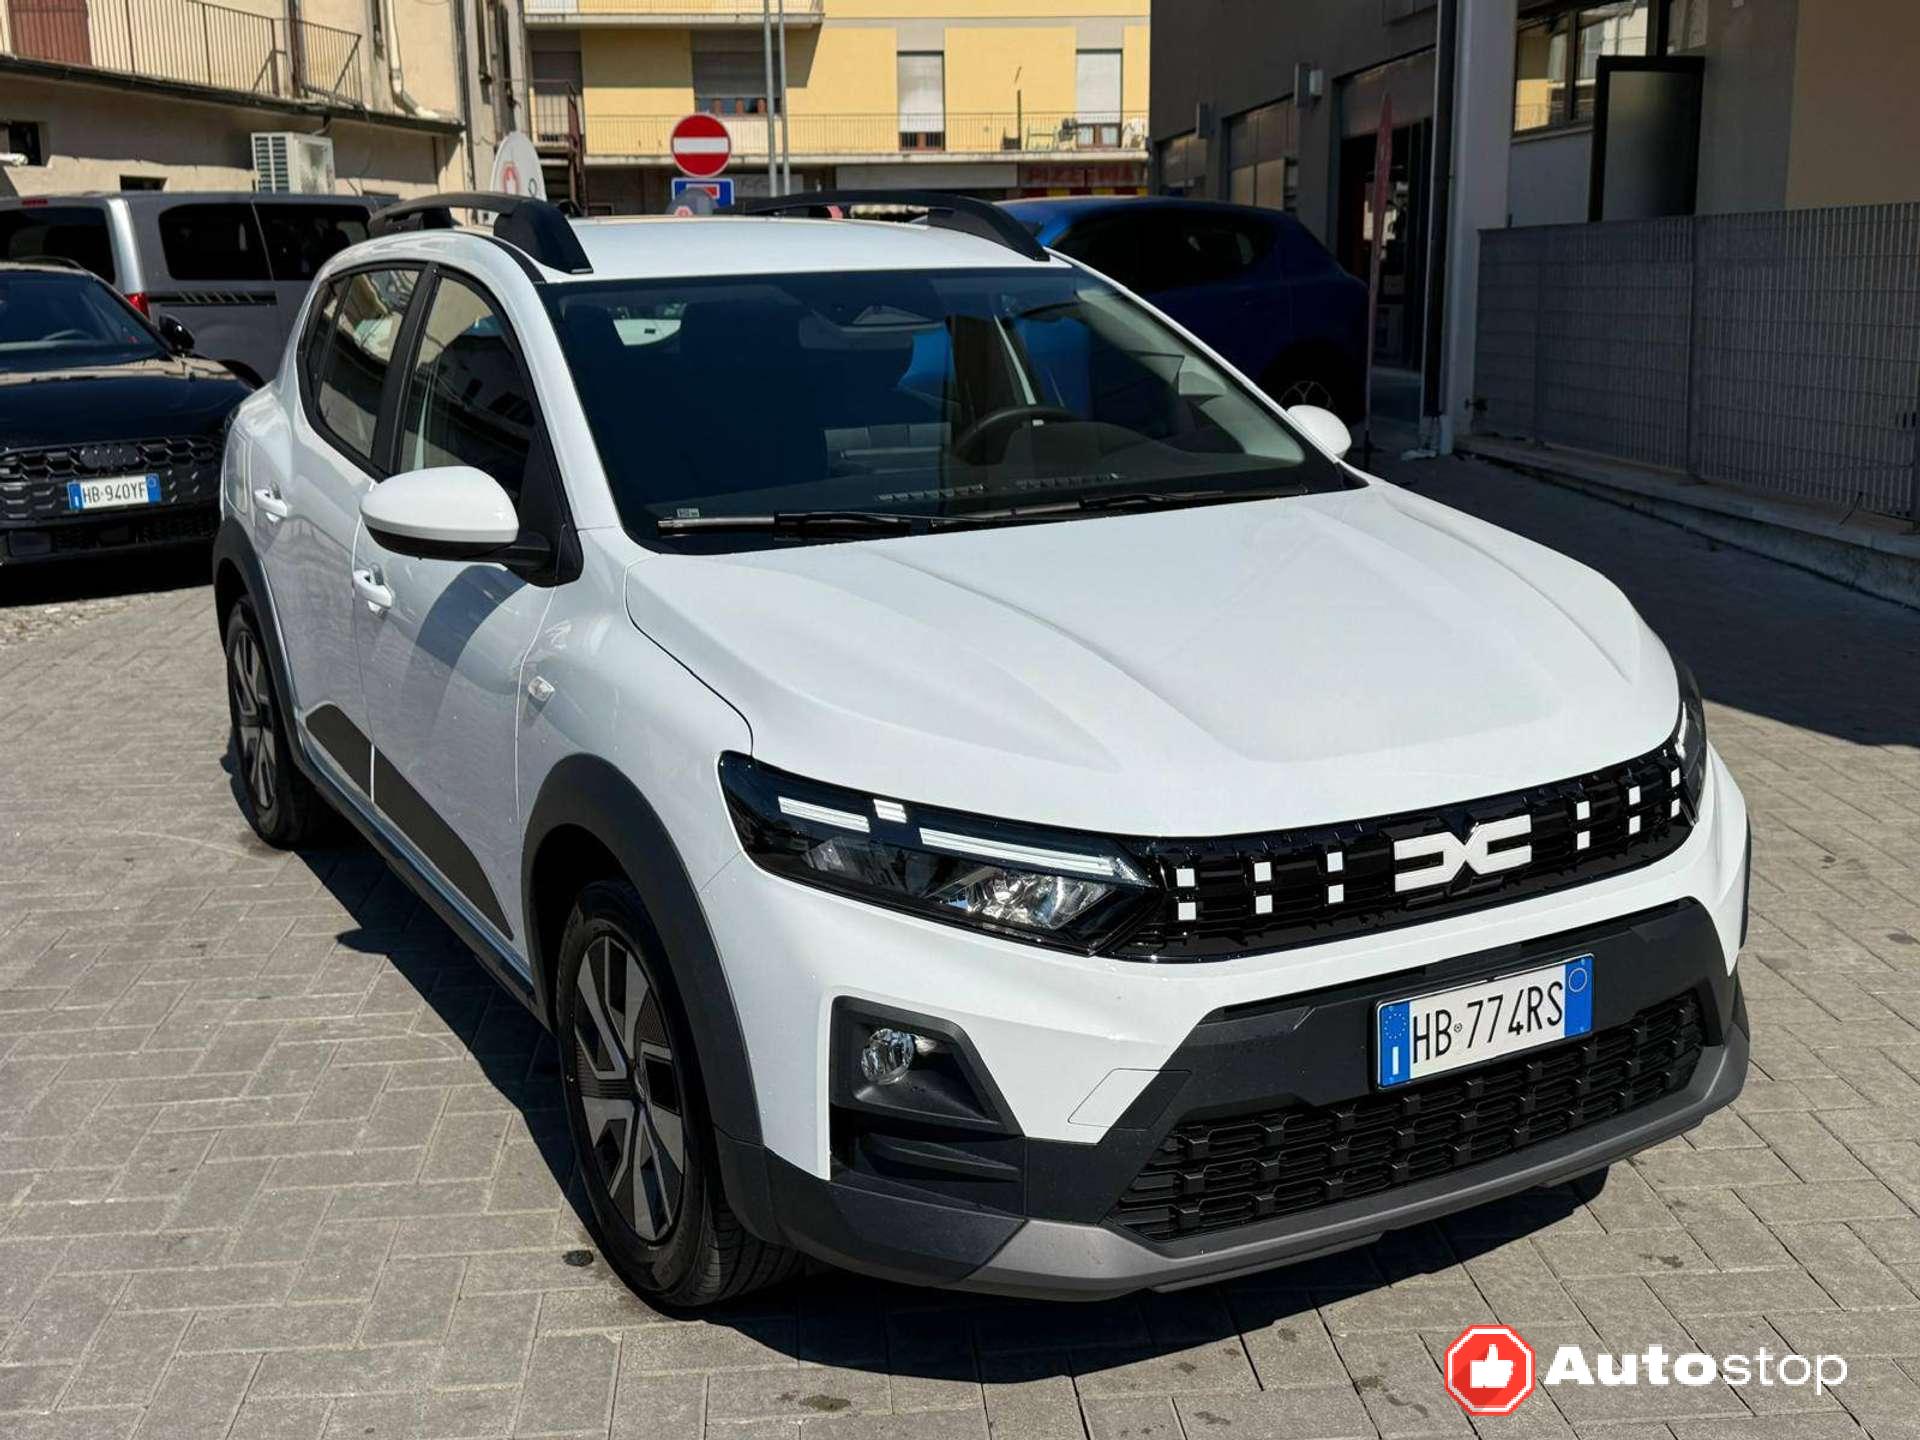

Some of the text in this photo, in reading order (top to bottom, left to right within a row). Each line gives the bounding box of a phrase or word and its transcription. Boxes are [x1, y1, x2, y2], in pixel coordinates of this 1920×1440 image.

[104, 482, 146, 501] 940YF
[1392, 981, 1564, 1075] I HB 774RS
